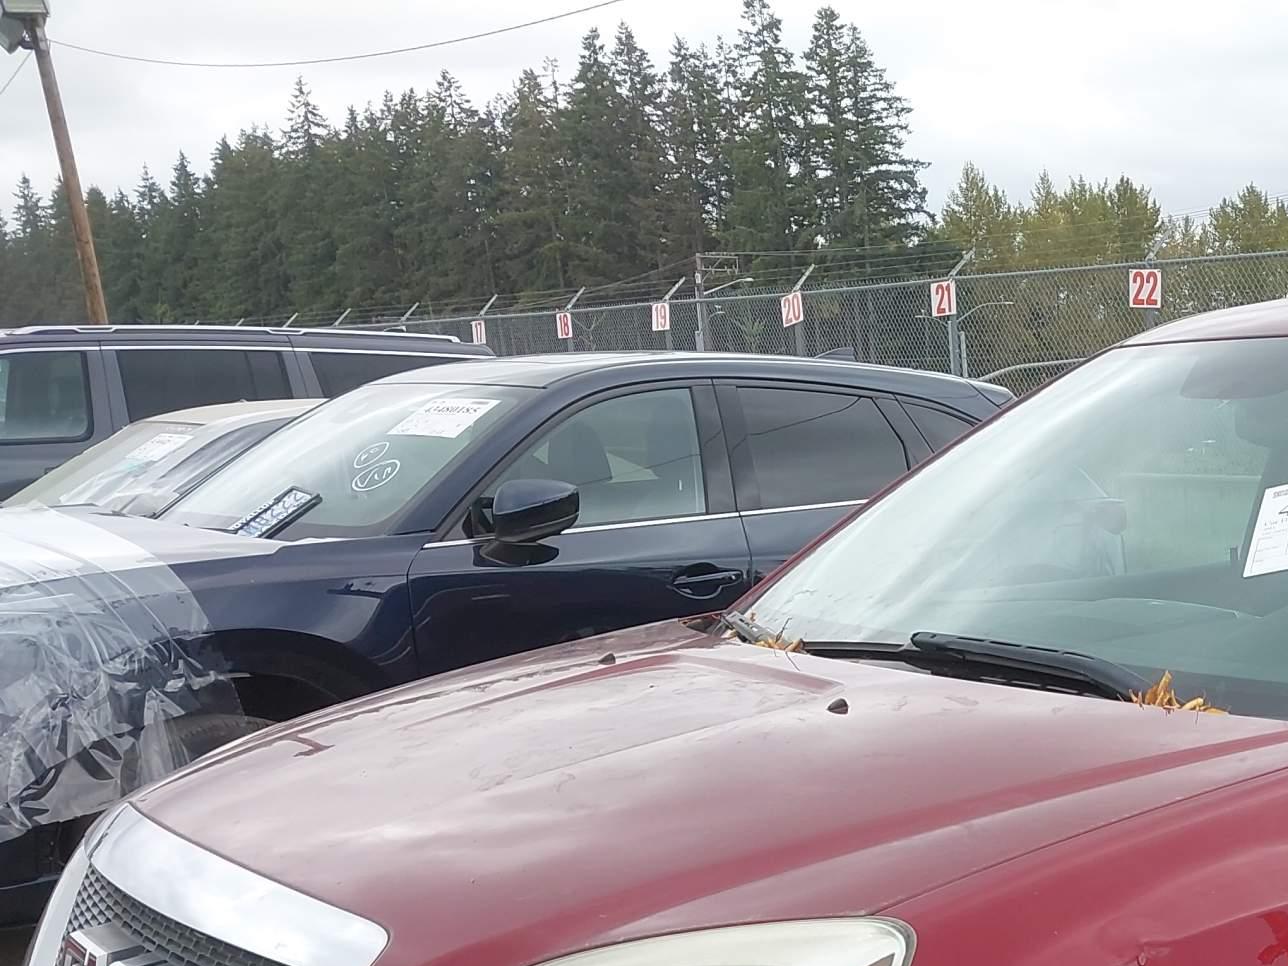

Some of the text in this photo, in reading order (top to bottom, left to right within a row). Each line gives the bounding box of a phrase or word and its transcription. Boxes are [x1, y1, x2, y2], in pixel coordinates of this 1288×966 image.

[935, 283, 952, 315] 21
[1131, 270, 1159, 306] 22
[654, 305, 667, 329] 19
[783, 293, 801, 325] 20
[558, 314, 570, 337] 18
